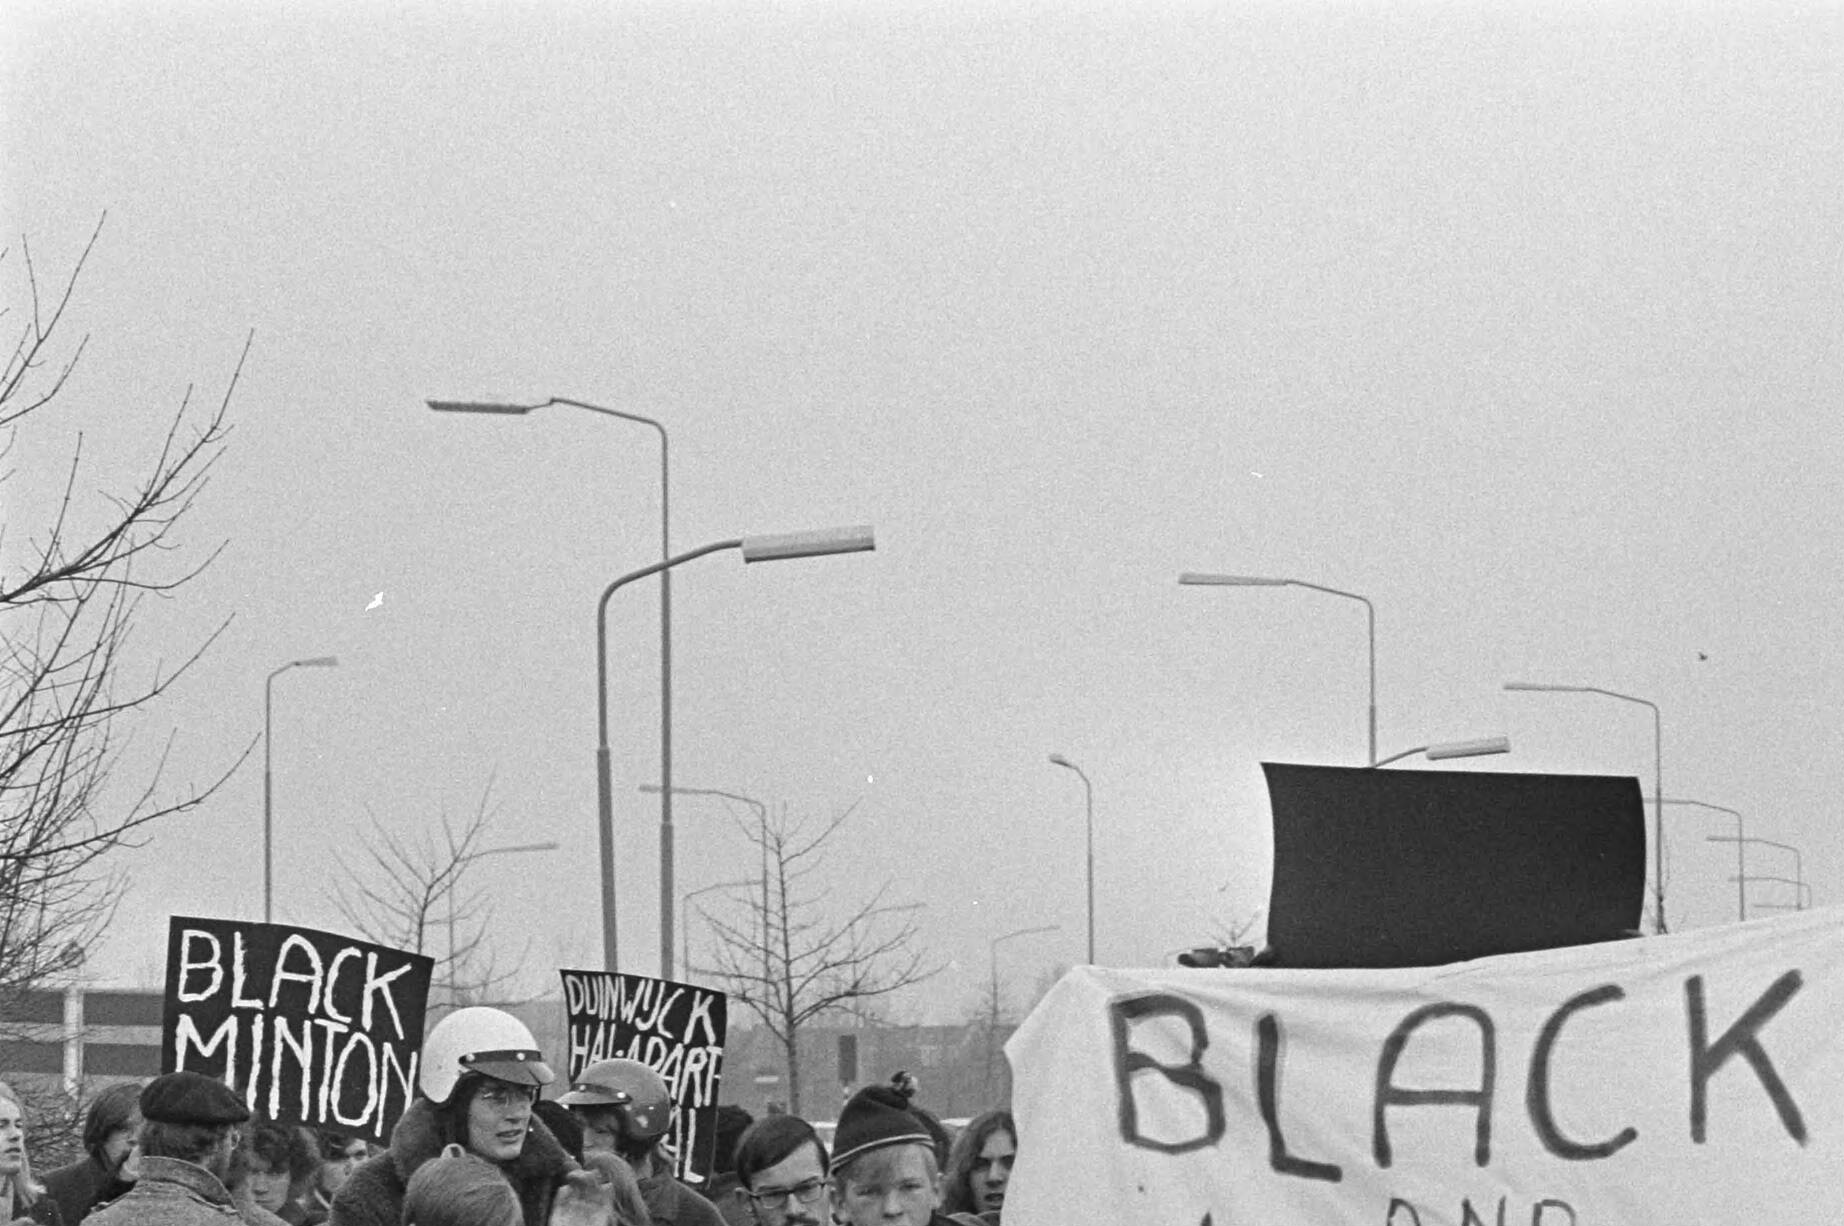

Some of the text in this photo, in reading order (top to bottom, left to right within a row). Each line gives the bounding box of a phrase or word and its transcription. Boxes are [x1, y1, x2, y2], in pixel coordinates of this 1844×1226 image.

[177, 928, 412, 1041] BLACK
[174, 1013, 418, 1138] MINTON
[1108, 966, 1812, 1185] BLACK
